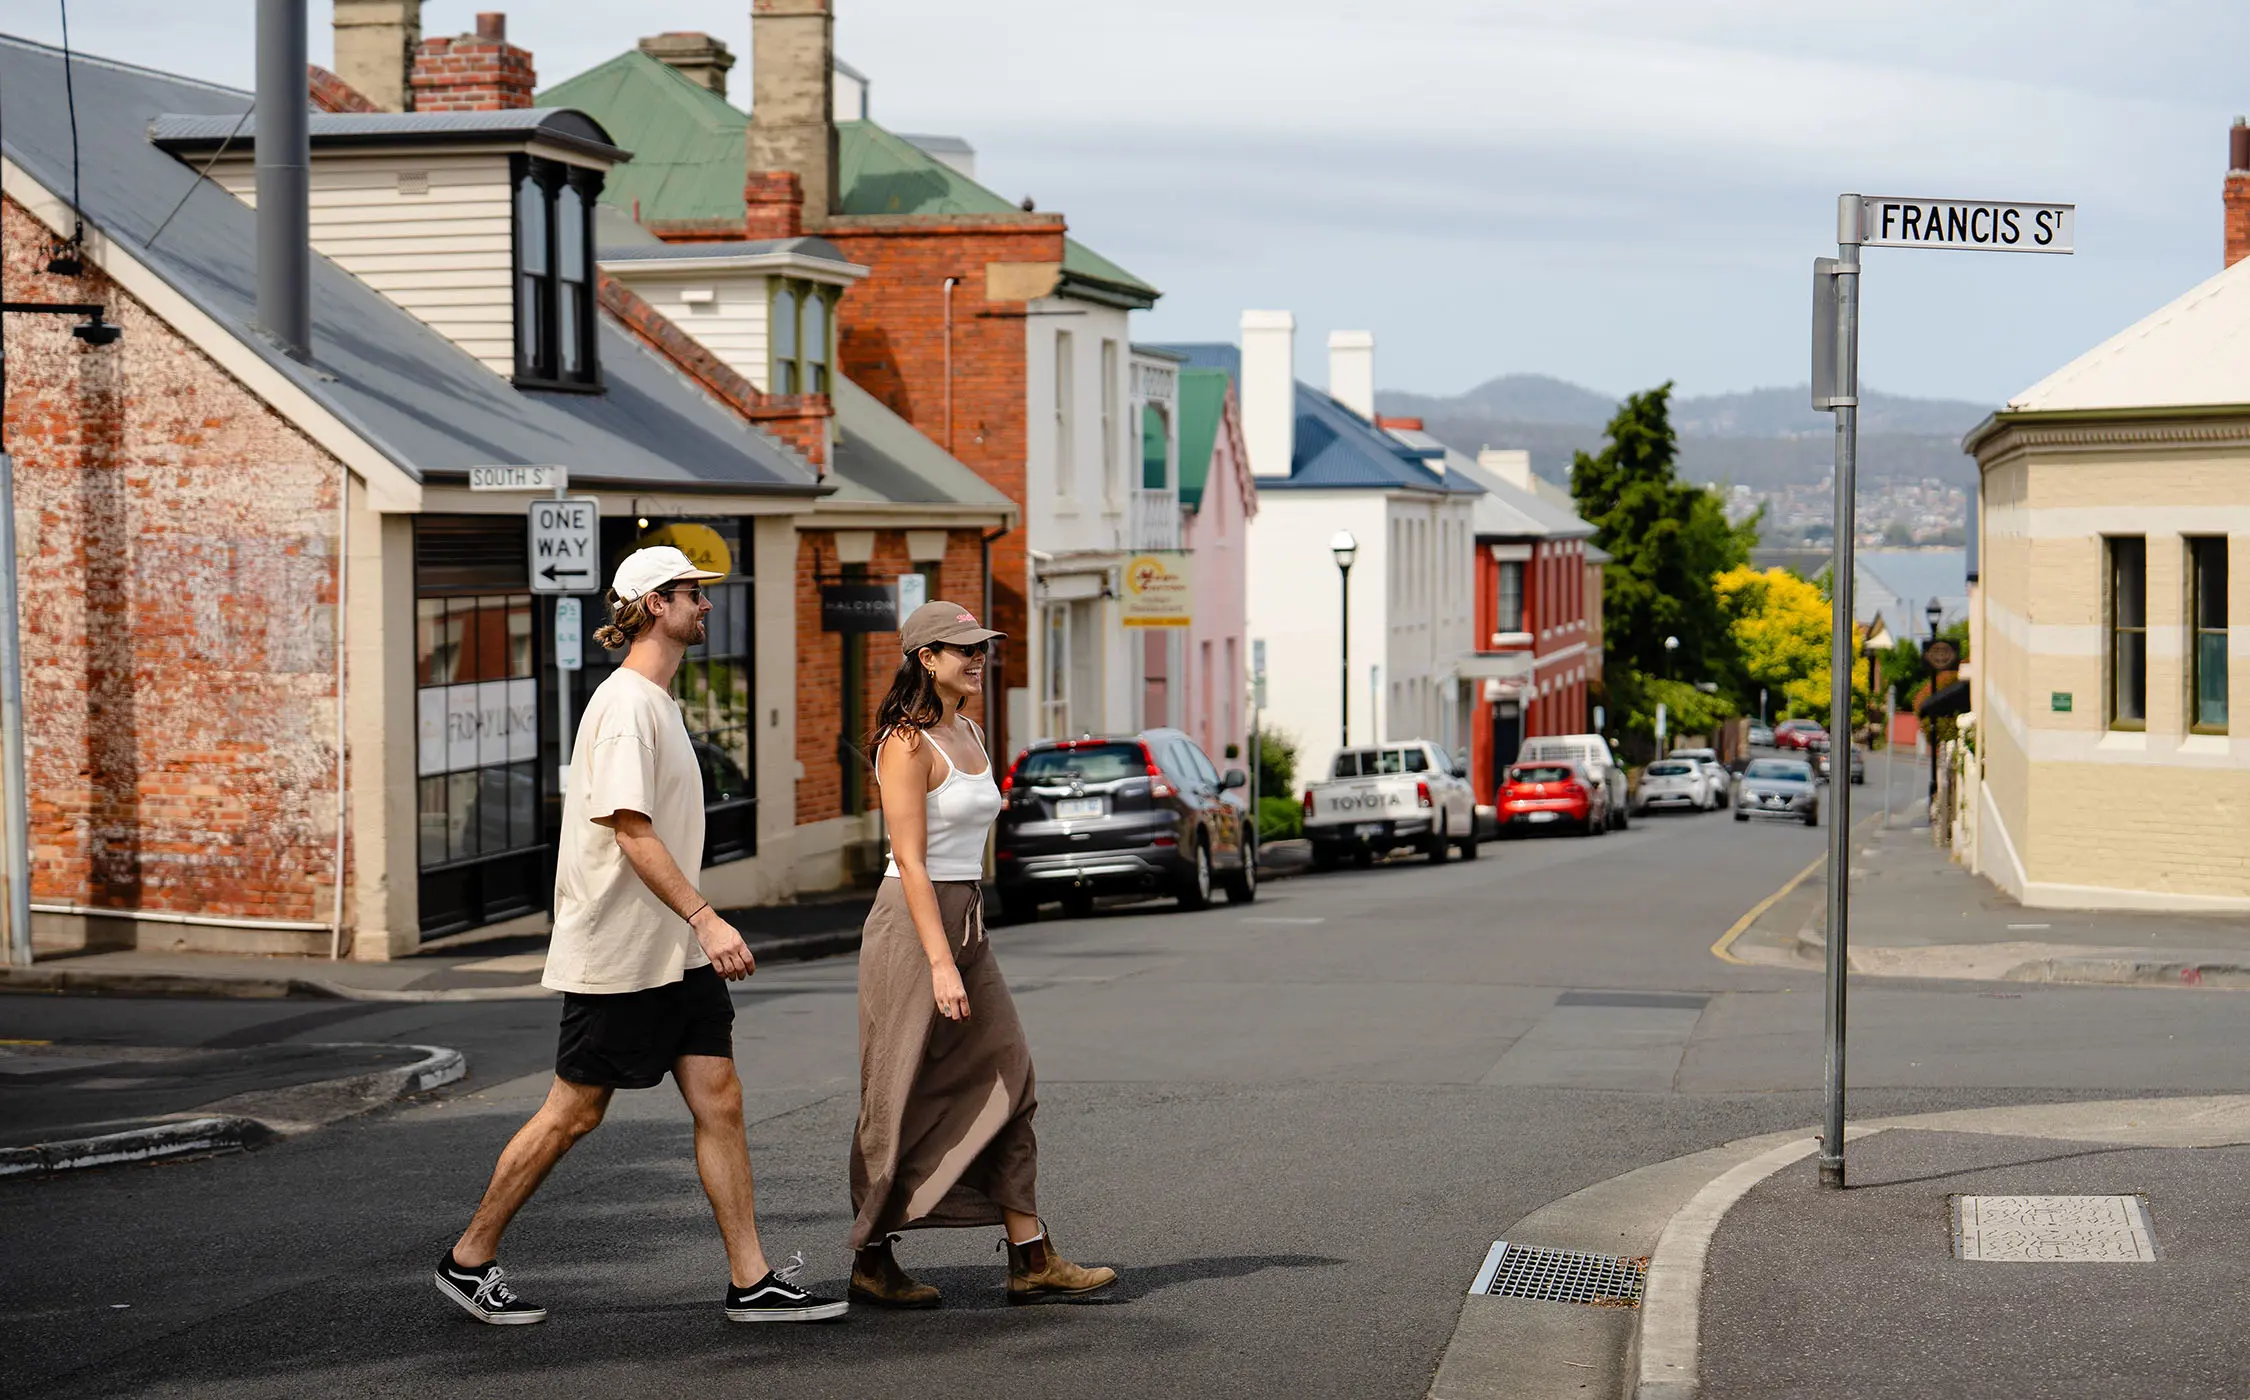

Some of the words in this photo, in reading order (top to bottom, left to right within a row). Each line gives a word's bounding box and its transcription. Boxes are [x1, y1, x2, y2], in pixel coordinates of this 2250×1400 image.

[1881, 203, 2021, 245] FRANCIS
[2033, 209, 2065, 246] ST
[473, 468, 527, 487] SOUTH
[540, 509, 586, 530] ONE
[537, 537, 589, 558] WAY
[1329, 792, 1402, 811] TOYOTA
